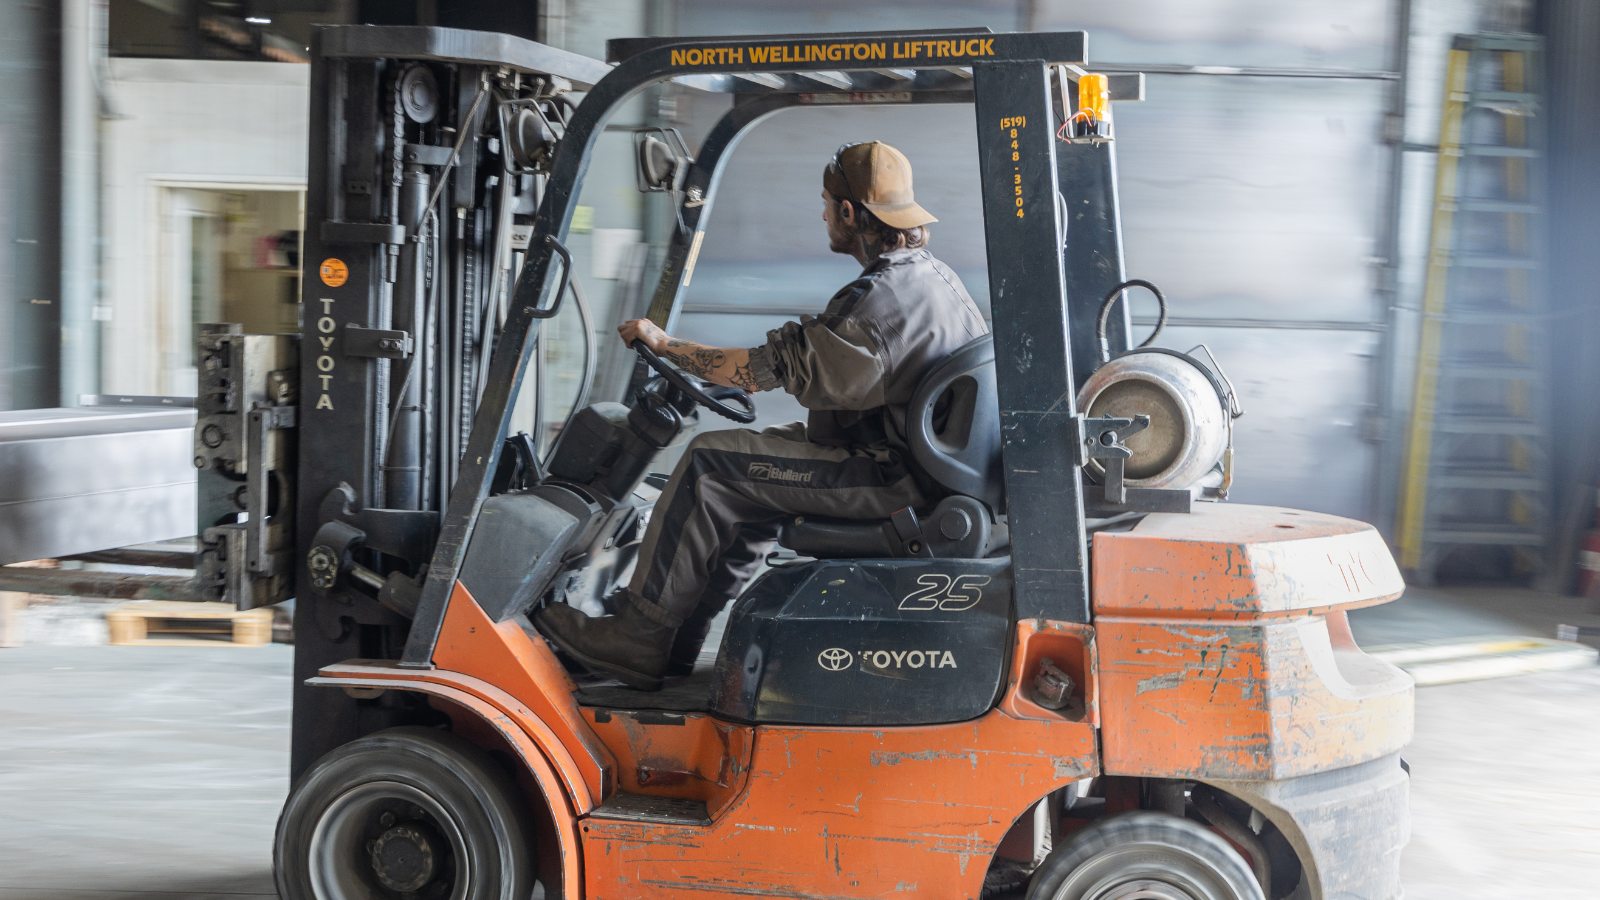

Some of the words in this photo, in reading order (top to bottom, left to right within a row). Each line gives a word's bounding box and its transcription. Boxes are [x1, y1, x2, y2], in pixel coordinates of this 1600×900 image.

[671, 47, 743, 66] NORTH
[748, 42, 887, 64] WELLINGTON
[893, 38, 995, 60] LIFTRUCK
[1000, 115, 1026, 130] (519)
[316, 298, 336, 410] TOYOTA
[770, 467, 813, 482] Bullard
[898, 573, 992, 611] 25
